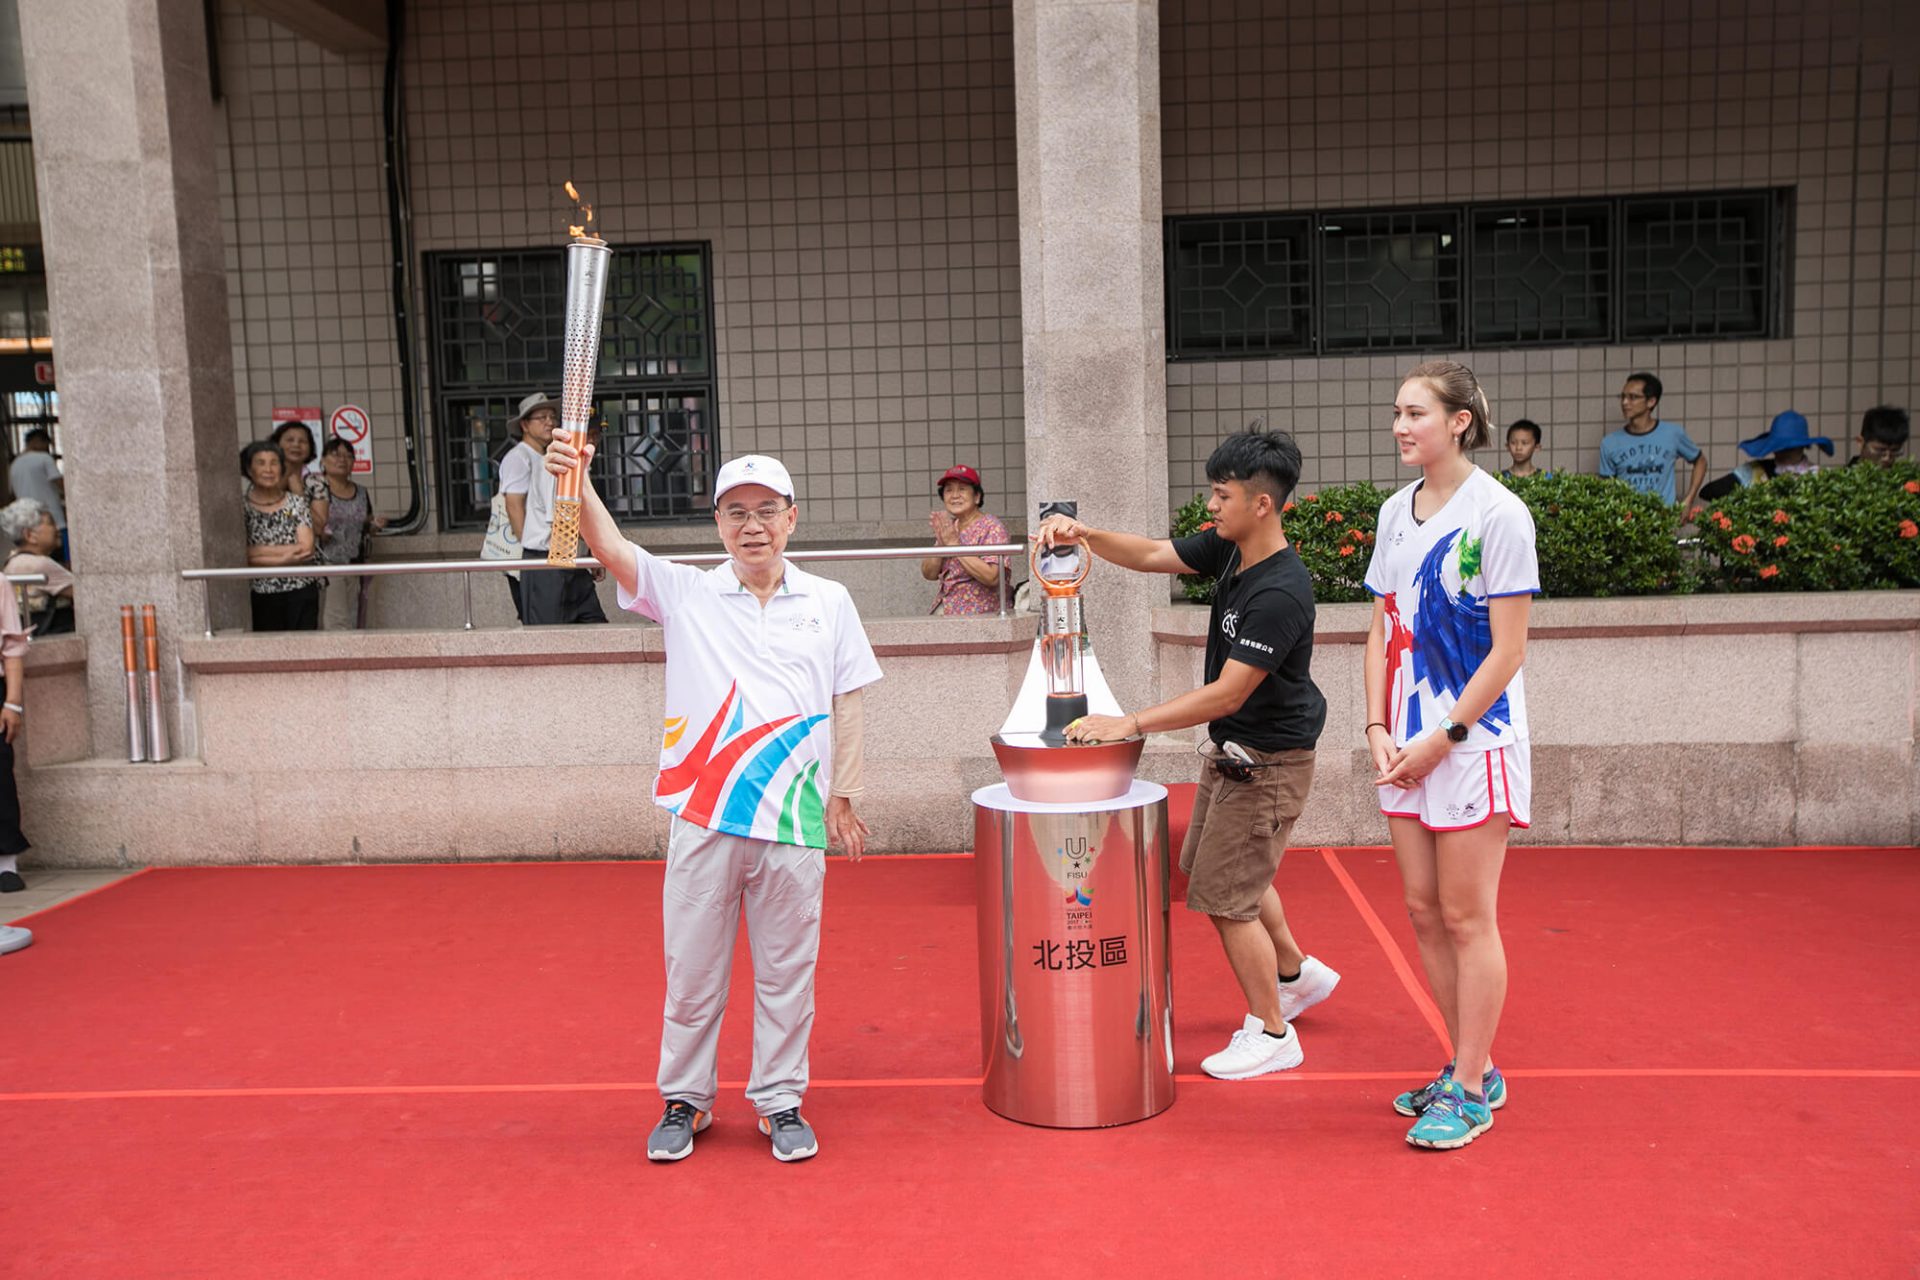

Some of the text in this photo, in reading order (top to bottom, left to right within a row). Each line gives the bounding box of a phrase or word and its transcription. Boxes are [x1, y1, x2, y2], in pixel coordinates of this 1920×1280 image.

[1066, 871, 1088, 879] FISU
[1066, 911, 1092, 919] TAIPEI
[1032, 935, 1127, 971] 北投區
